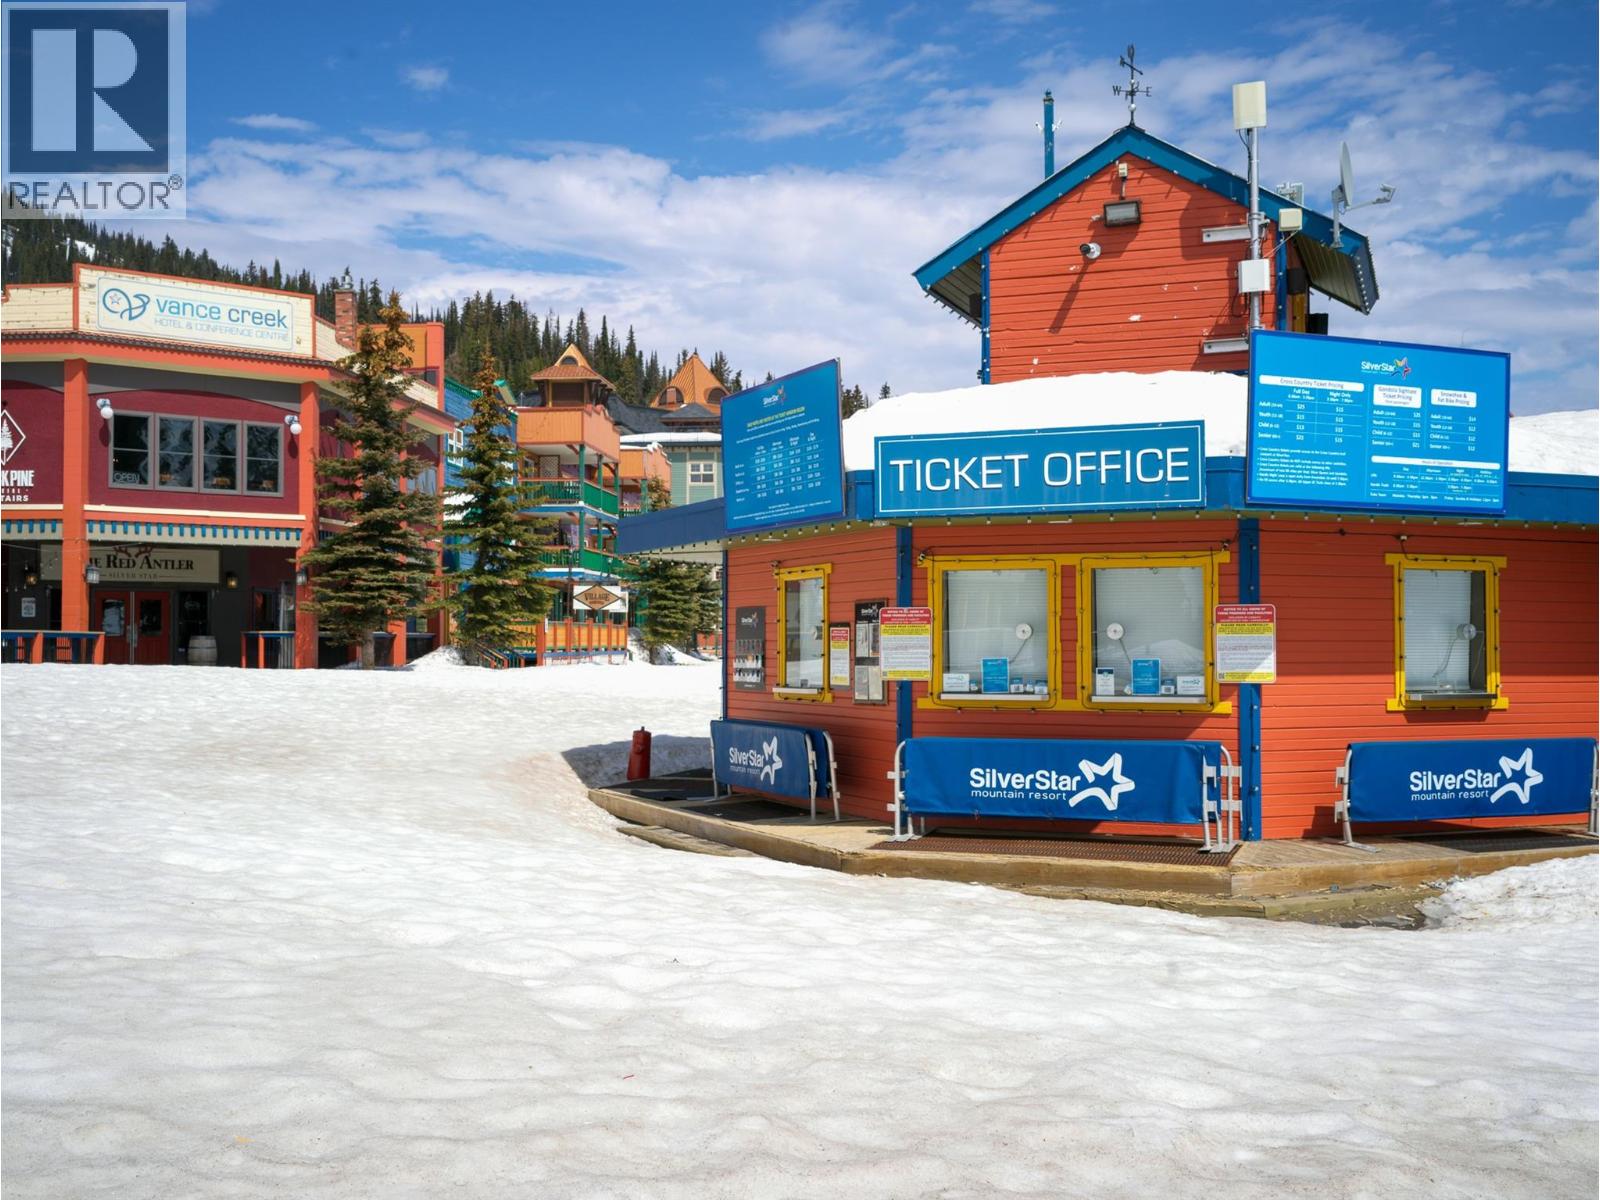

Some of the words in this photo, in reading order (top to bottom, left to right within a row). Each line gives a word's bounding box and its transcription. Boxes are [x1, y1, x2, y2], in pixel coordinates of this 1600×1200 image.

[156, 298, 221, 320] vance
[228, 309, 288, 329] creek
[155, 318, 185, 329] HOTEL
[194, 323, 252, 338] CONFERENCE
[255, 329, 289, 341] CENTRE
[1361, 361, 1396, 371] SilverStar
[113, 472, 140, 482] OPEN
[889, 453, 1029, 492] TICKET
[1043, 447, 1189, 487] OFFICE
[10, 470, 35, 487] PINE
[106, 554, 136, 569] RED
[140, 554, 195, 570] ANTLER
[584, 592, 610, 601] VILLAGE
[728, 747, 764, 767] SilverStar
[970, 767, 1081, 791] SilverStar
[1409, 769, 1501, 791] SilverStar
[971, 789, 1025, 799] mountain
[1029, 791, 1067, 801] resort
[1411, 791, 1455, 801] mountain
[1459, 789, 1489, 799] resort
